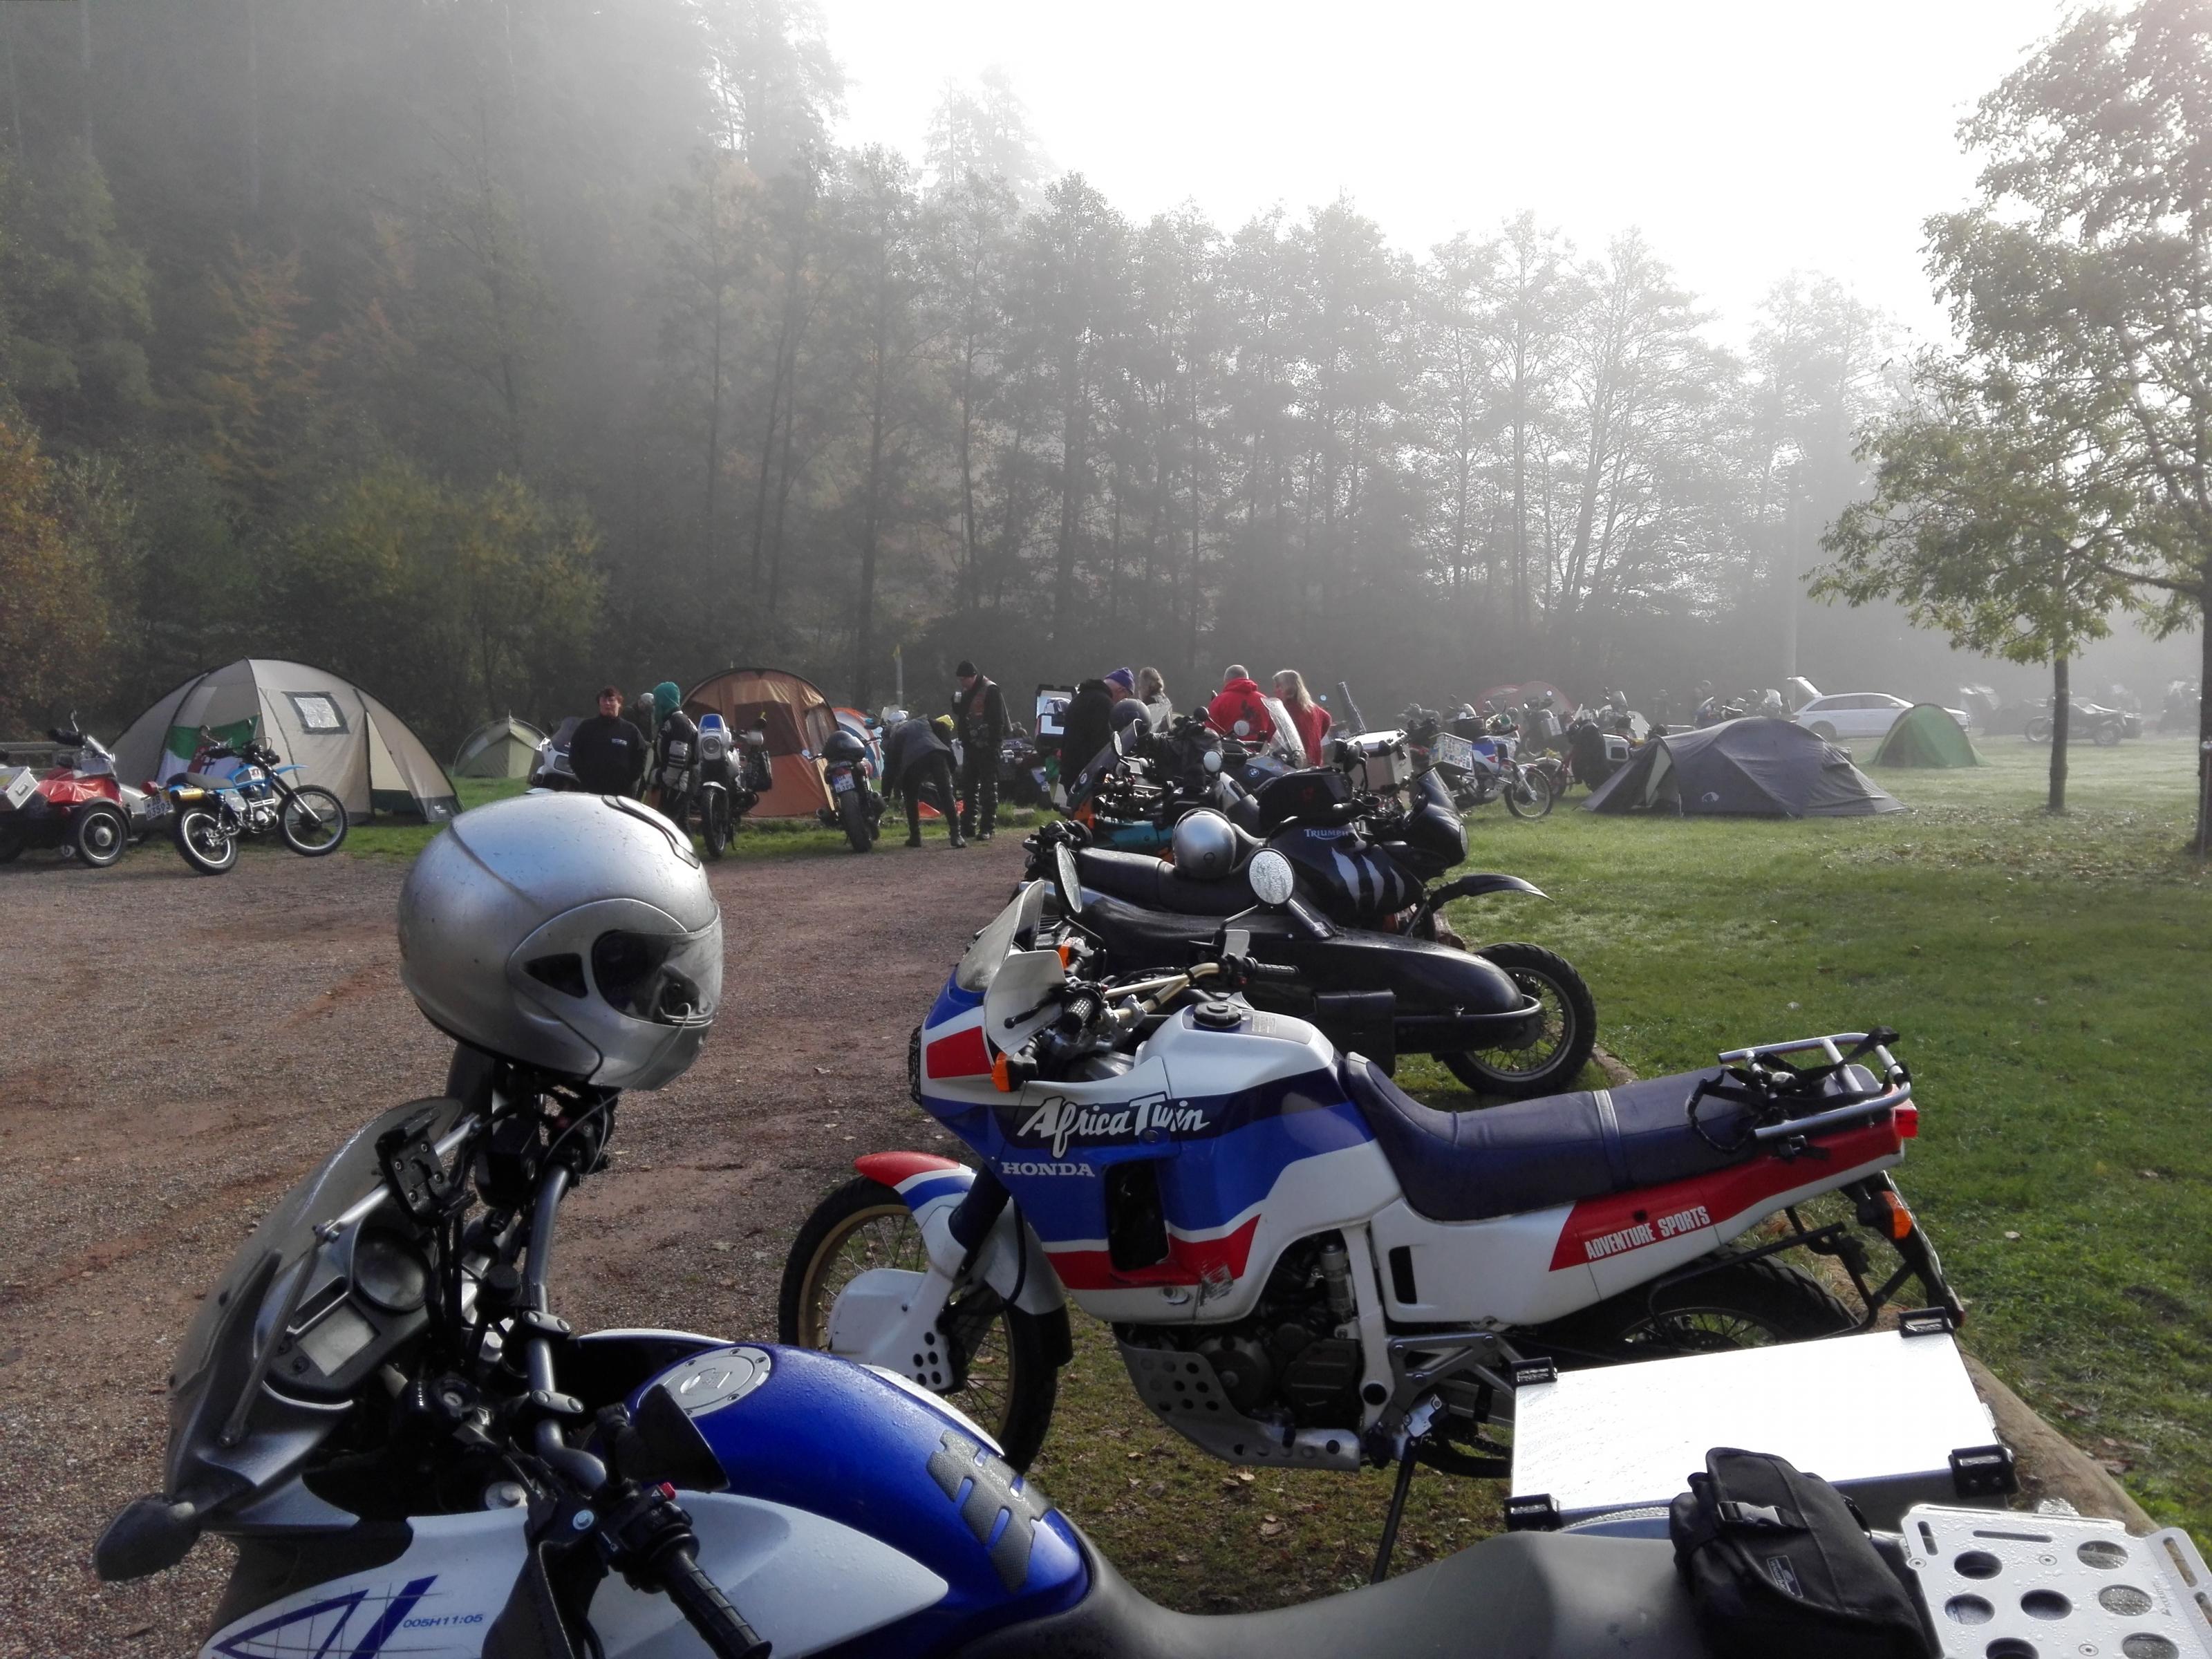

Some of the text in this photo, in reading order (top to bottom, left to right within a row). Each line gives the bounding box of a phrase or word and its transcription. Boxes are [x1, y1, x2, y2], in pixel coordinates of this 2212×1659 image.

[1304, 829, 1349, 838] TRIUMPH
[1017, 1093, 1210, 1159] Africa Twin
[1001, 1162, 1095, 1177] HONDA
[1584, 1205, 1711, 1260] ADVENTURE SPORTS
